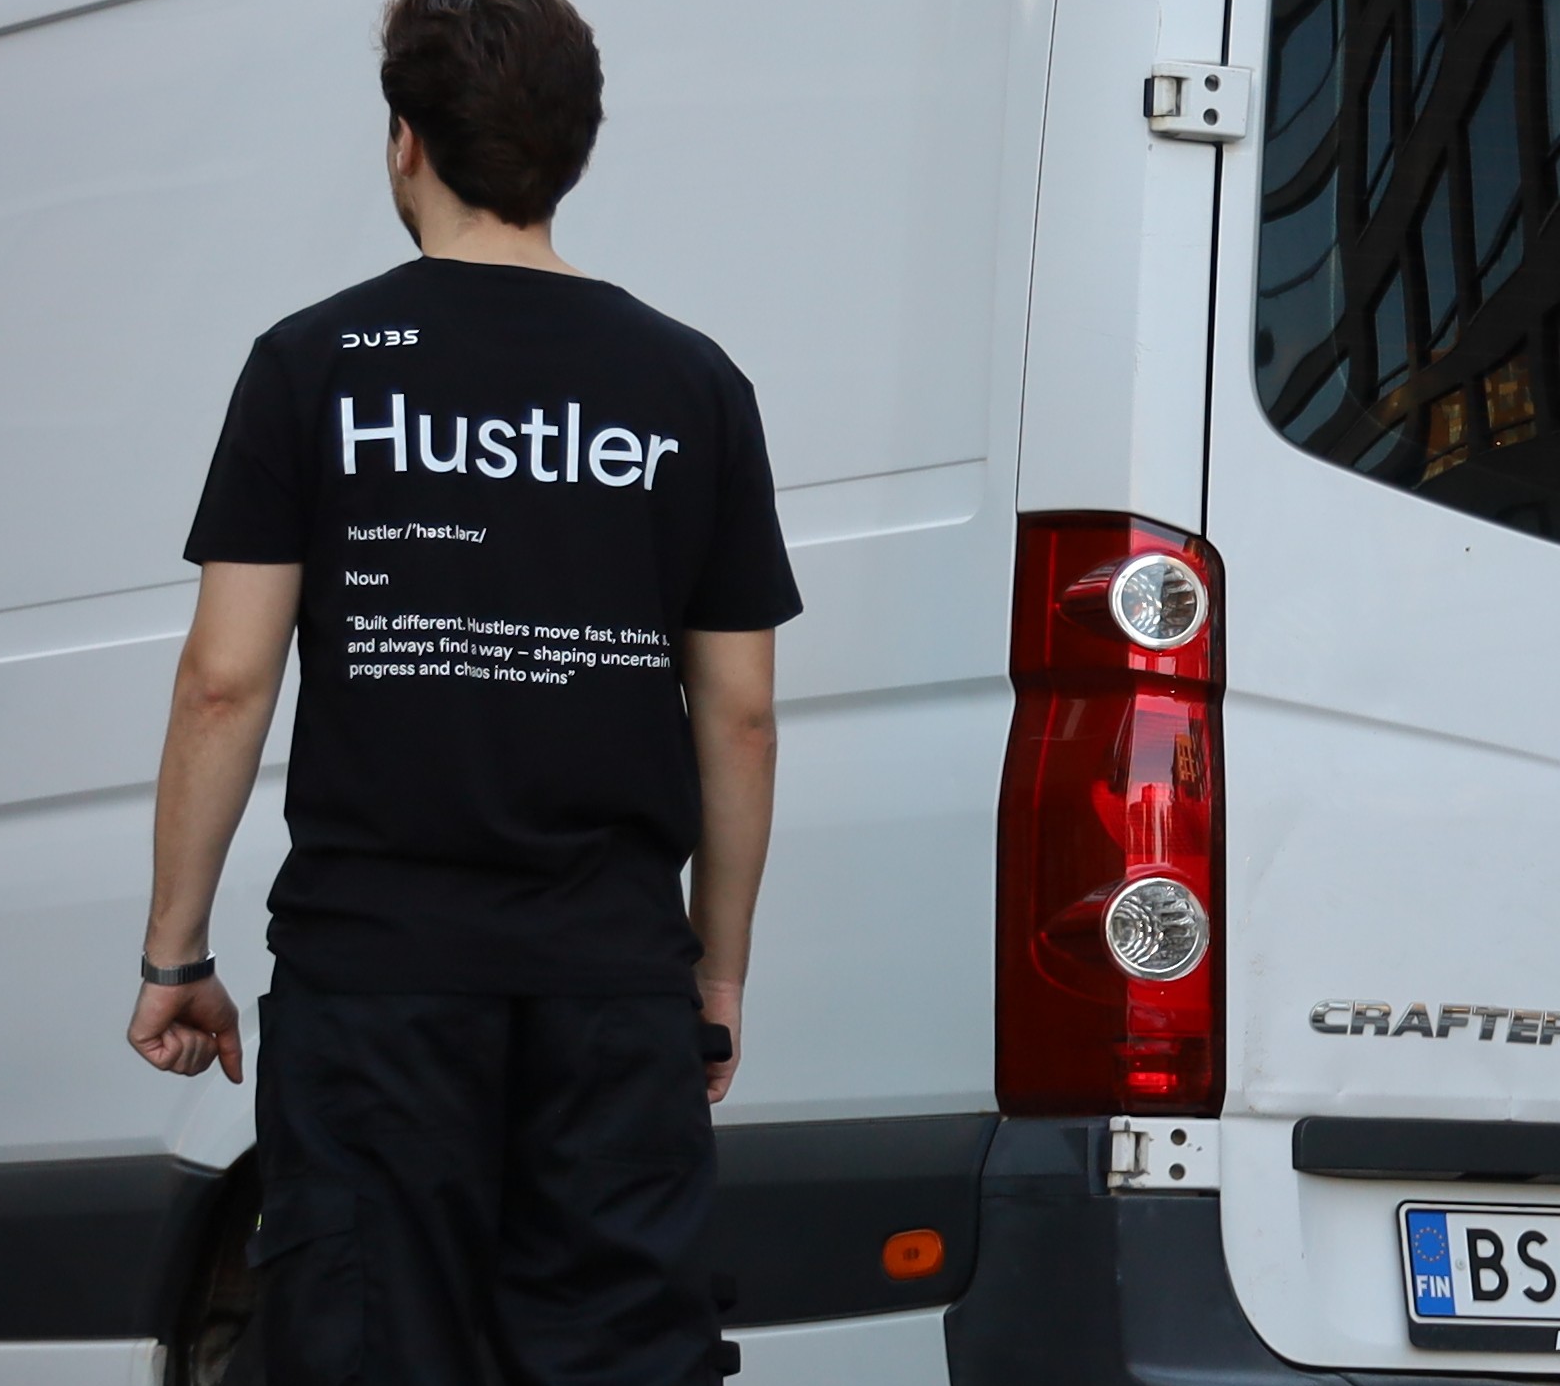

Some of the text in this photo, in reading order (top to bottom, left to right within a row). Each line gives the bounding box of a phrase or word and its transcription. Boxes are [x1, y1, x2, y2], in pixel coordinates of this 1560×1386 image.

[340, 393, 679, 491] Hustler
[347, 524, 403, 541] Hustler
[345, 570, 389, 586] Noun
[391, 614, 466, 631] different.
[467, 617, 530, 637] Hustlers
[534, 626, 580, 641] move
[584, 625, 617, 645] fast,
[619, 627, 660, 646] think
[347, 637, 376, 654] and
[379, 637, 435, 657] always
[439, 636, 469, 654] find
[470, 643, 477, 656] a
[478, 644, 514, 662] way
[533, 645, 597, 668] shaping
[349, 663, 416, 680] progress
[418, 660, 449, 676] and
[454, 661, 491, 680] chaos
[493, 664, 527, 682] into
[1415, 1275, 1452, 1299] FIN
